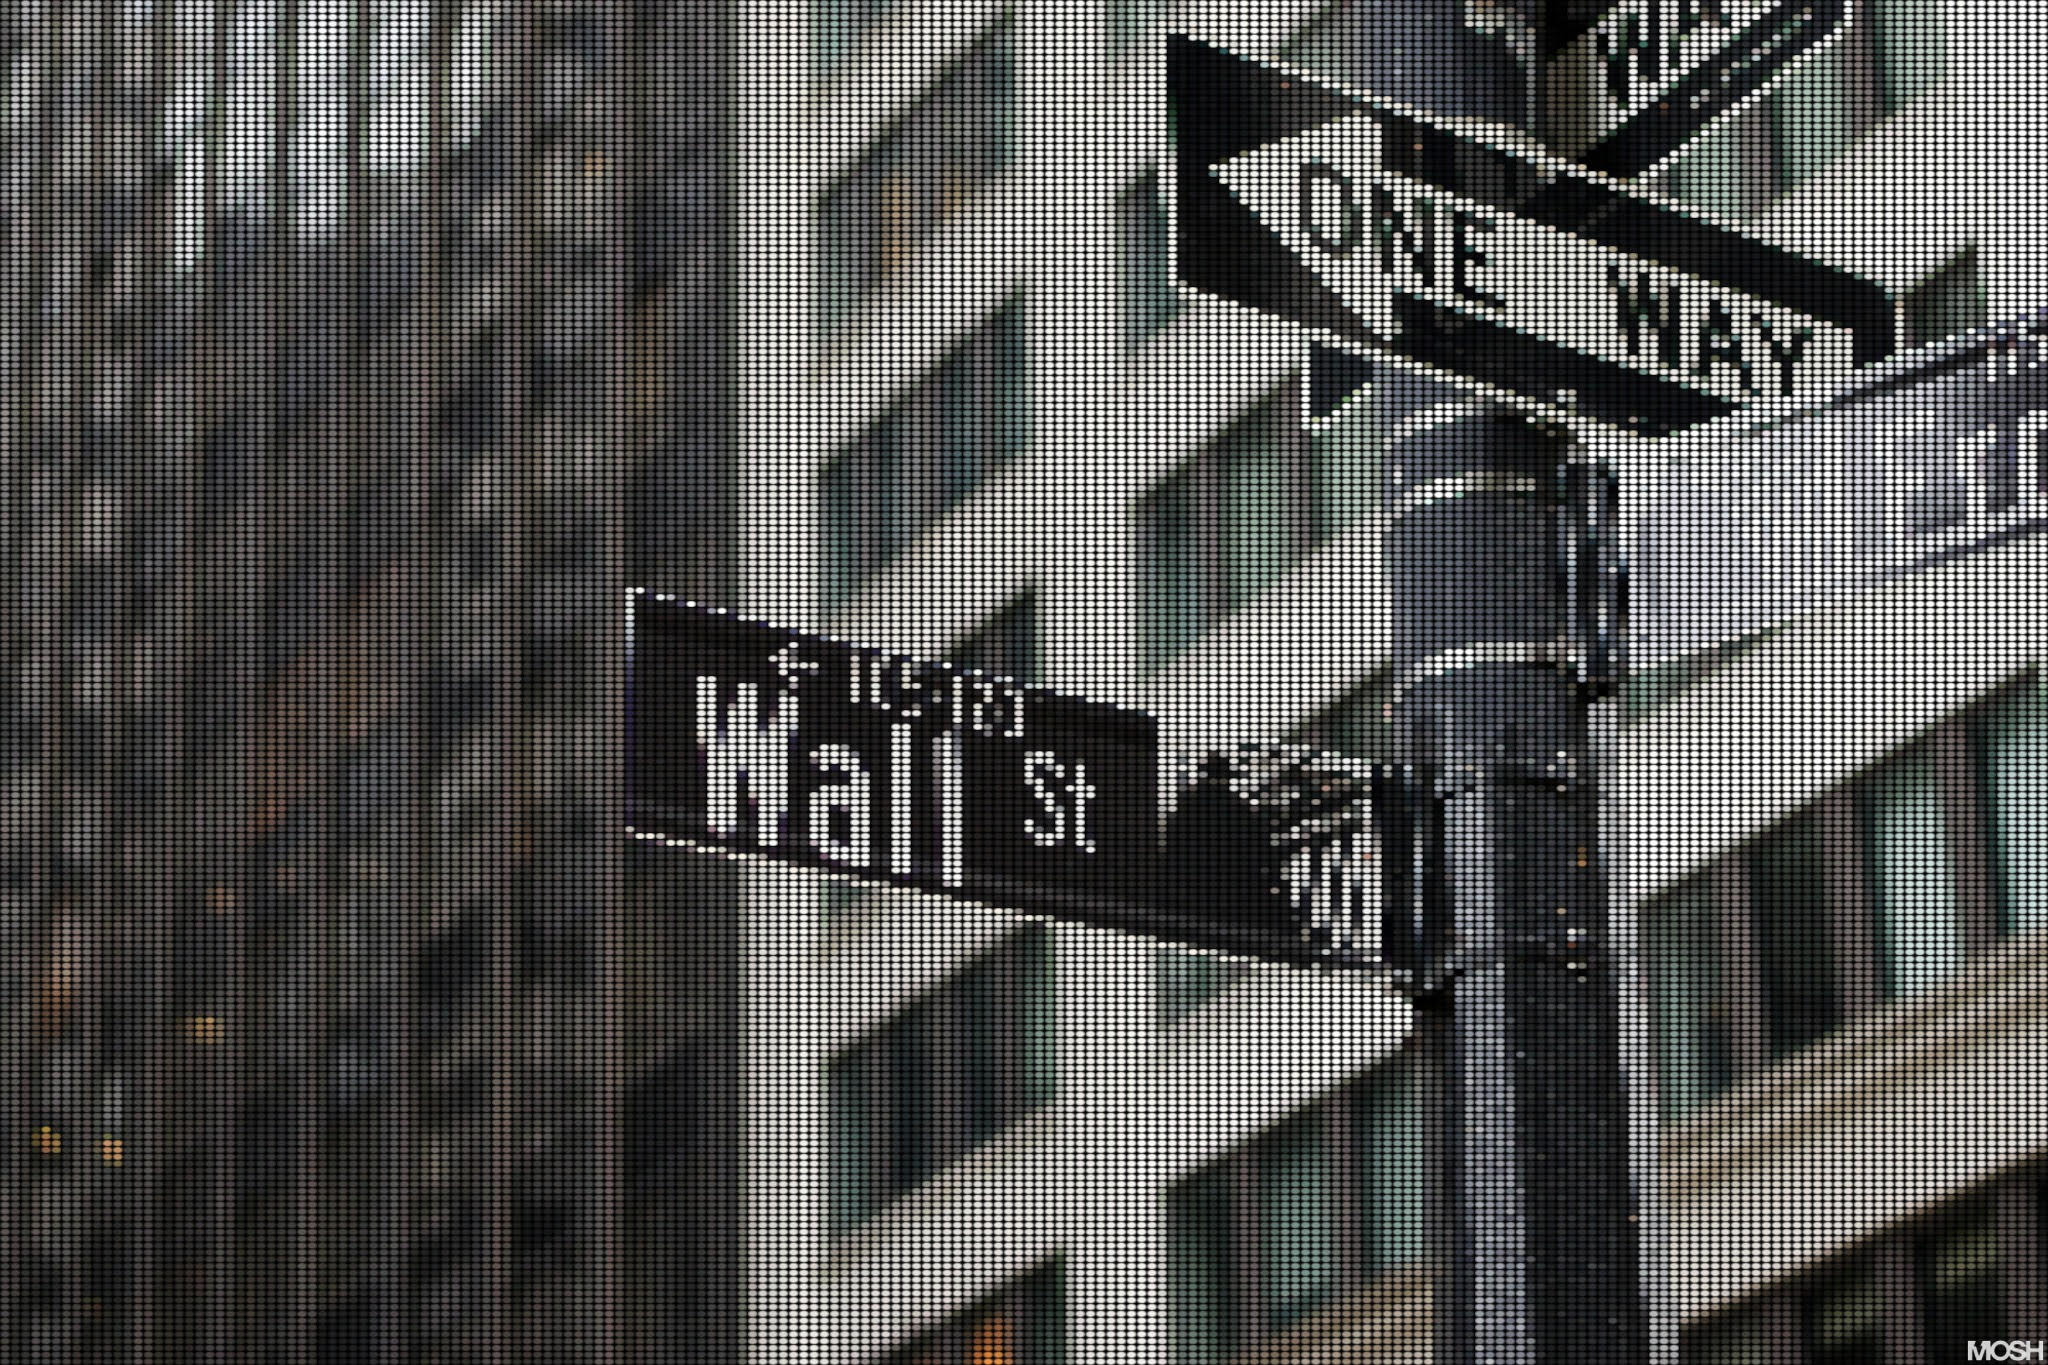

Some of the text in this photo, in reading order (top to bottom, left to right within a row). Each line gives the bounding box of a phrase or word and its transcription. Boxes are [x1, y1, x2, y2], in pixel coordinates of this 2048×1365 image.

[1300, 160, 1815, 398] ONE WAY
[696, 675, 1096, 888] Wall St
